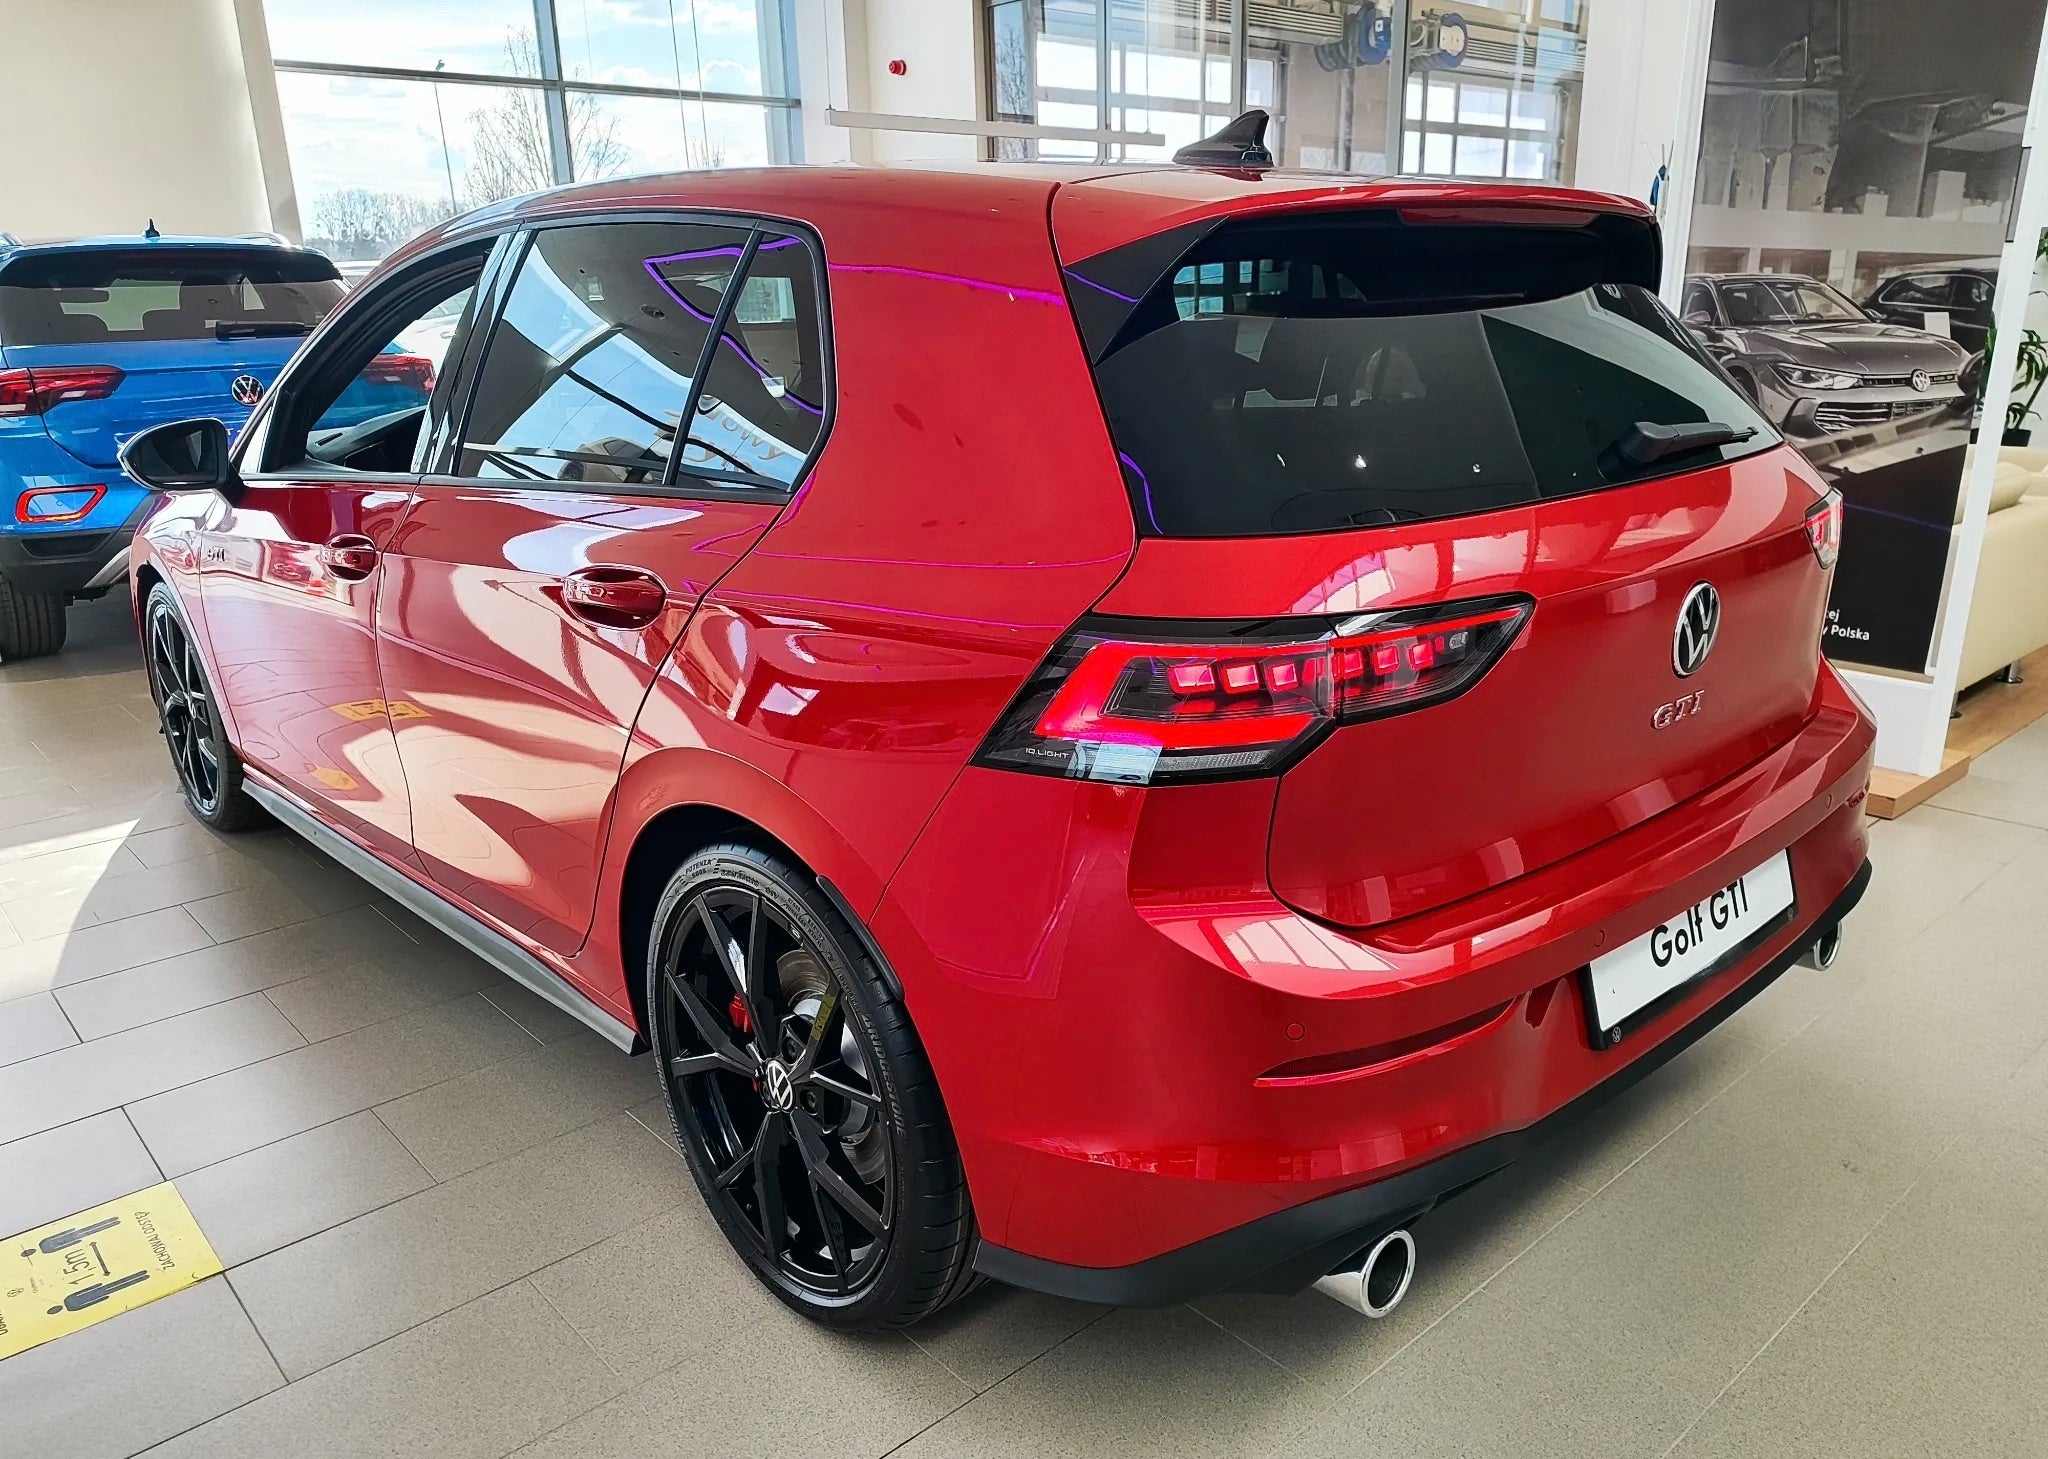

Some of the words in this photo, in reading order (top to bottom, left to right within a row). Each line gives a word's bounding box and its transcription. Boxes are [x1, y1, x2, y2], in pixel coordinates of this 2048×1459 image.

[1830, 624, 1870, 641] Polska
[1653, 689, 1705, 730] GTI
[1650, 903, 1704, 968] Golf
[1709, 876, 1749, 931] GTI
[861, 1012, 908, 1138] BRIDGESTONE
[134, 1210, 156, 1235] ODSTĘP
[146, 1233, 176, 1271] ZACHOWAJ
